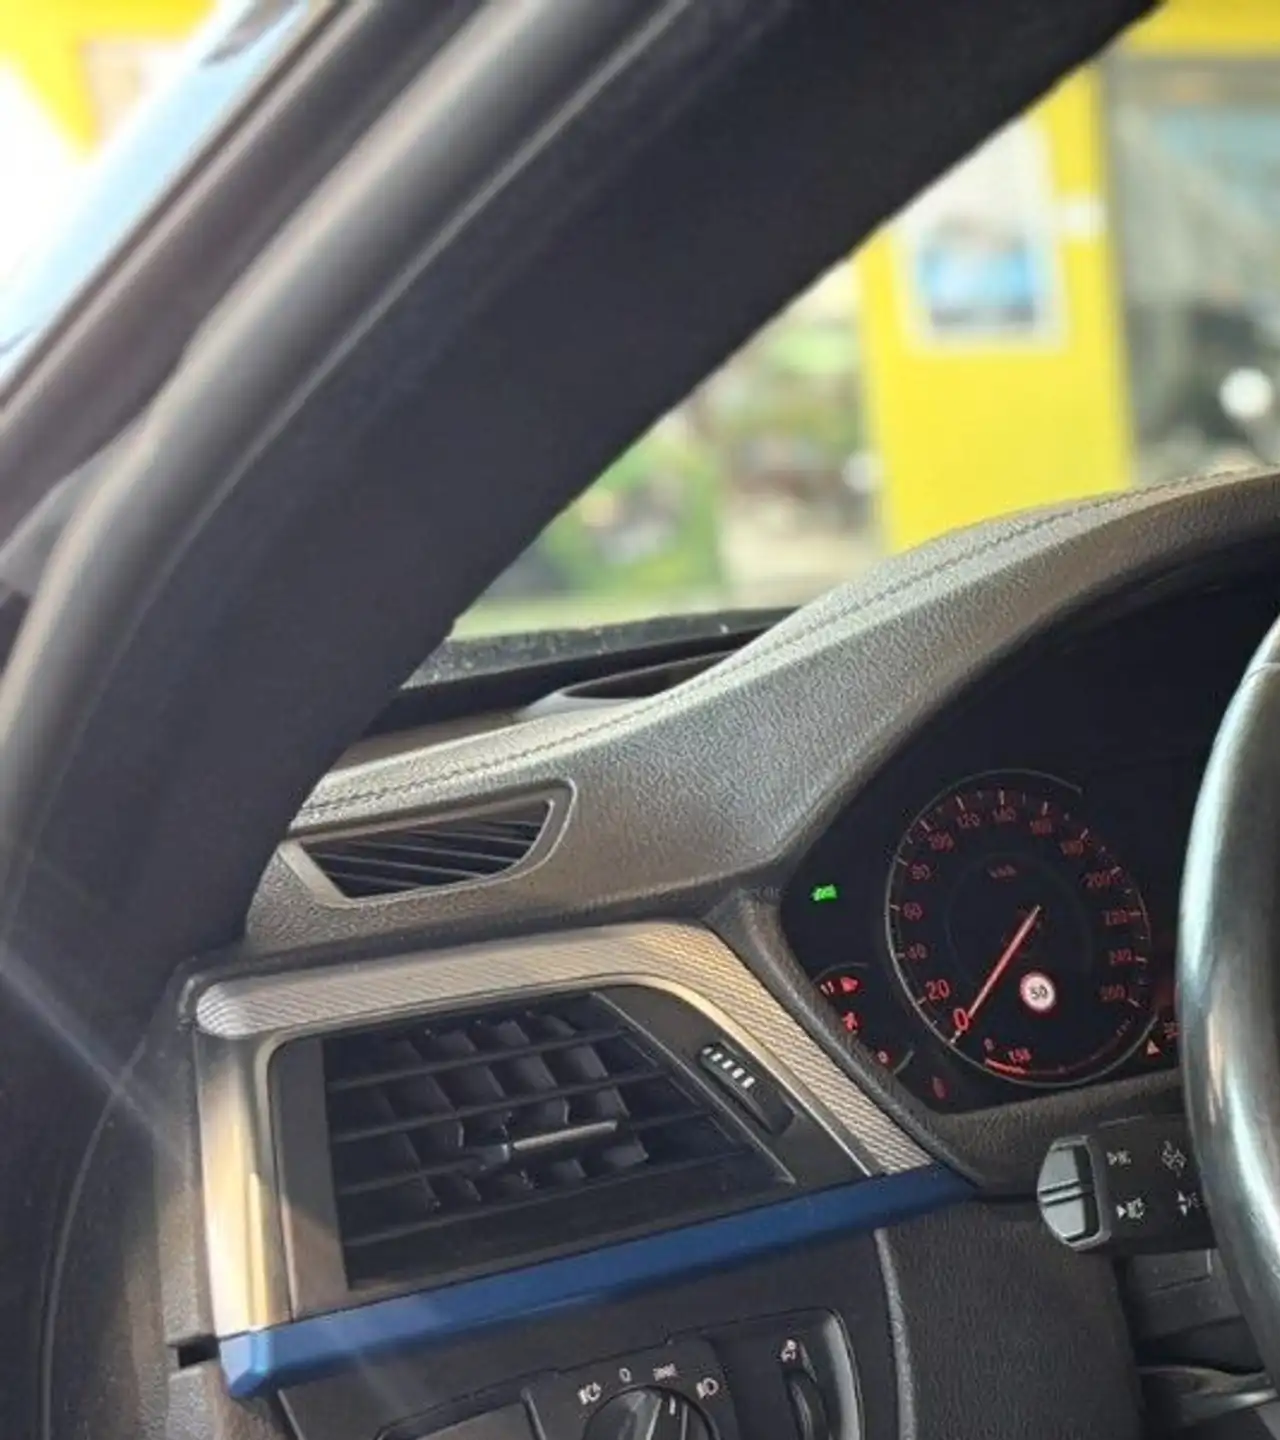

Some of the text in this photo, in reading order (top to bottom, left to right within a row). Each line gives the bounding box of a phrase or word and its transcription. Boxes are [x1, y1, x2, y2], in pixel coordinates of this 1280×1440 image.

[925, 978, 950, 1001] 20
[1030, 984, 1048, 1001] 50
[953, 1007, 969, 1031] 0
